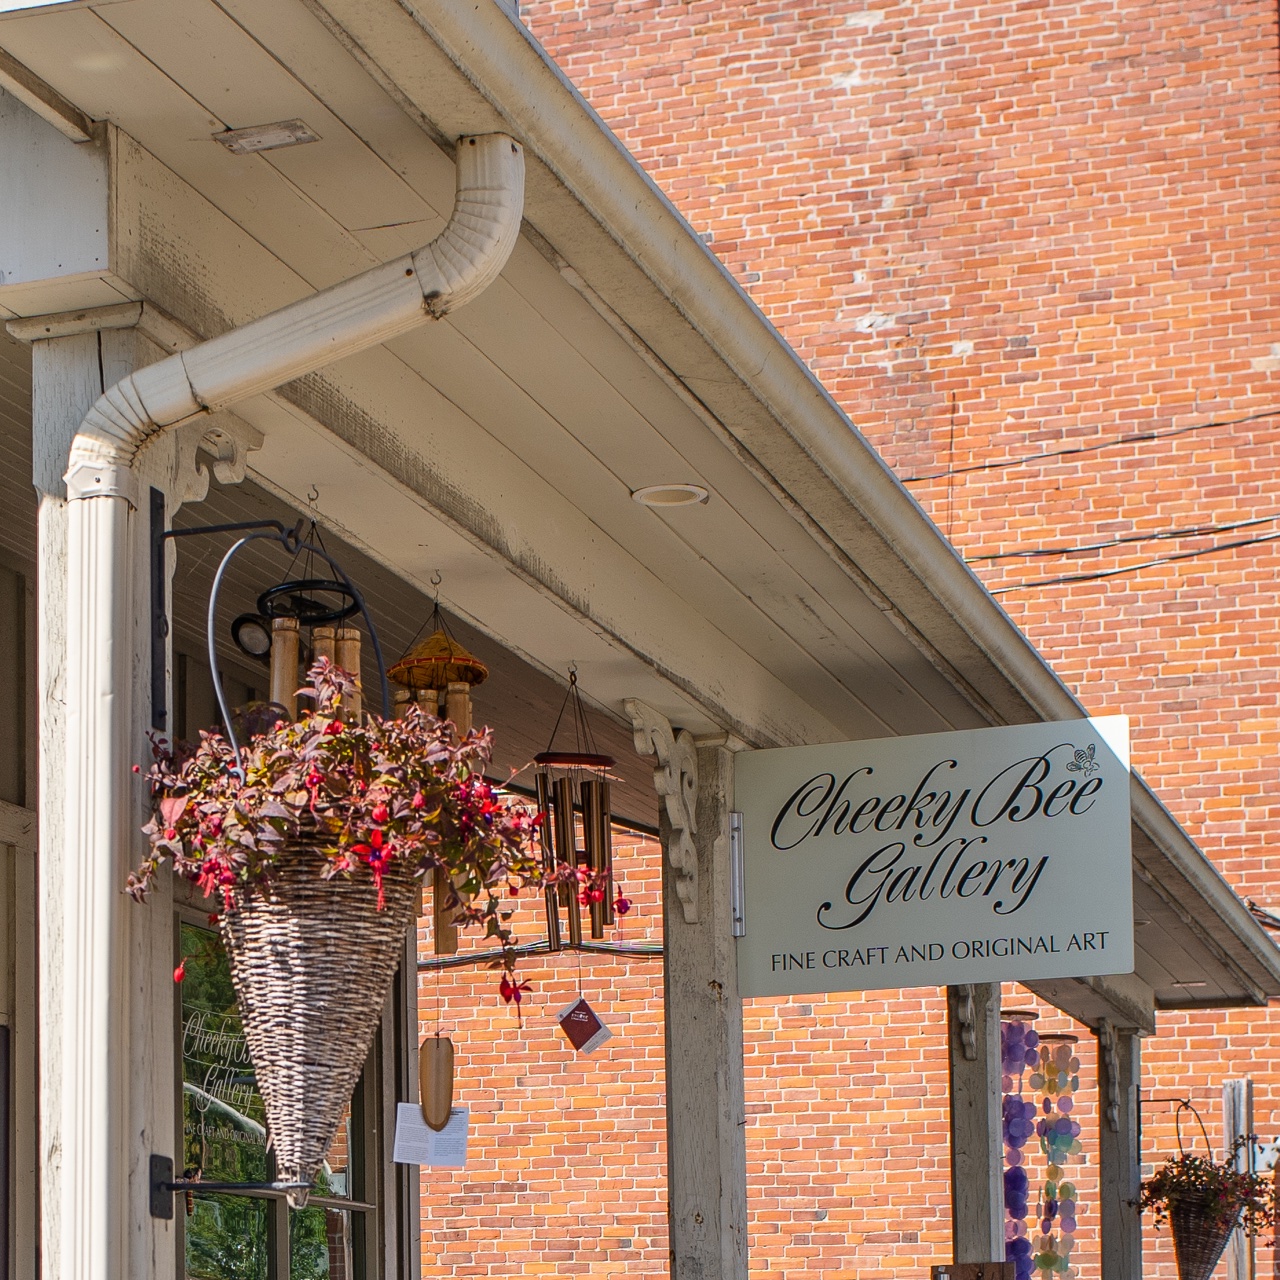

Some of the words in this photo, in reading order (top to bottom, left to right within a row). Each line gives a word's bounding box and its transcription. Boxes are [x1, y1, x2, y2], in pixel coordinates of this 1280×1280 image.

[770, 759, 971, 850] Cheeky
[970, 743, 1104, 828] Bee
[816, 836, 1050, 930] Gallery
[771, 951, 816, 971] FINE
[822, 946, 890, 968] CRAFT
[894, 943, 945, 963] AND
[951, 936, 1061, 960] ORIGINAL
[1066, 931, 1110, 952] ART
[182, 1011, 234, 1069] Cheeky
[196, 1063, 254, 1117] Gallery
